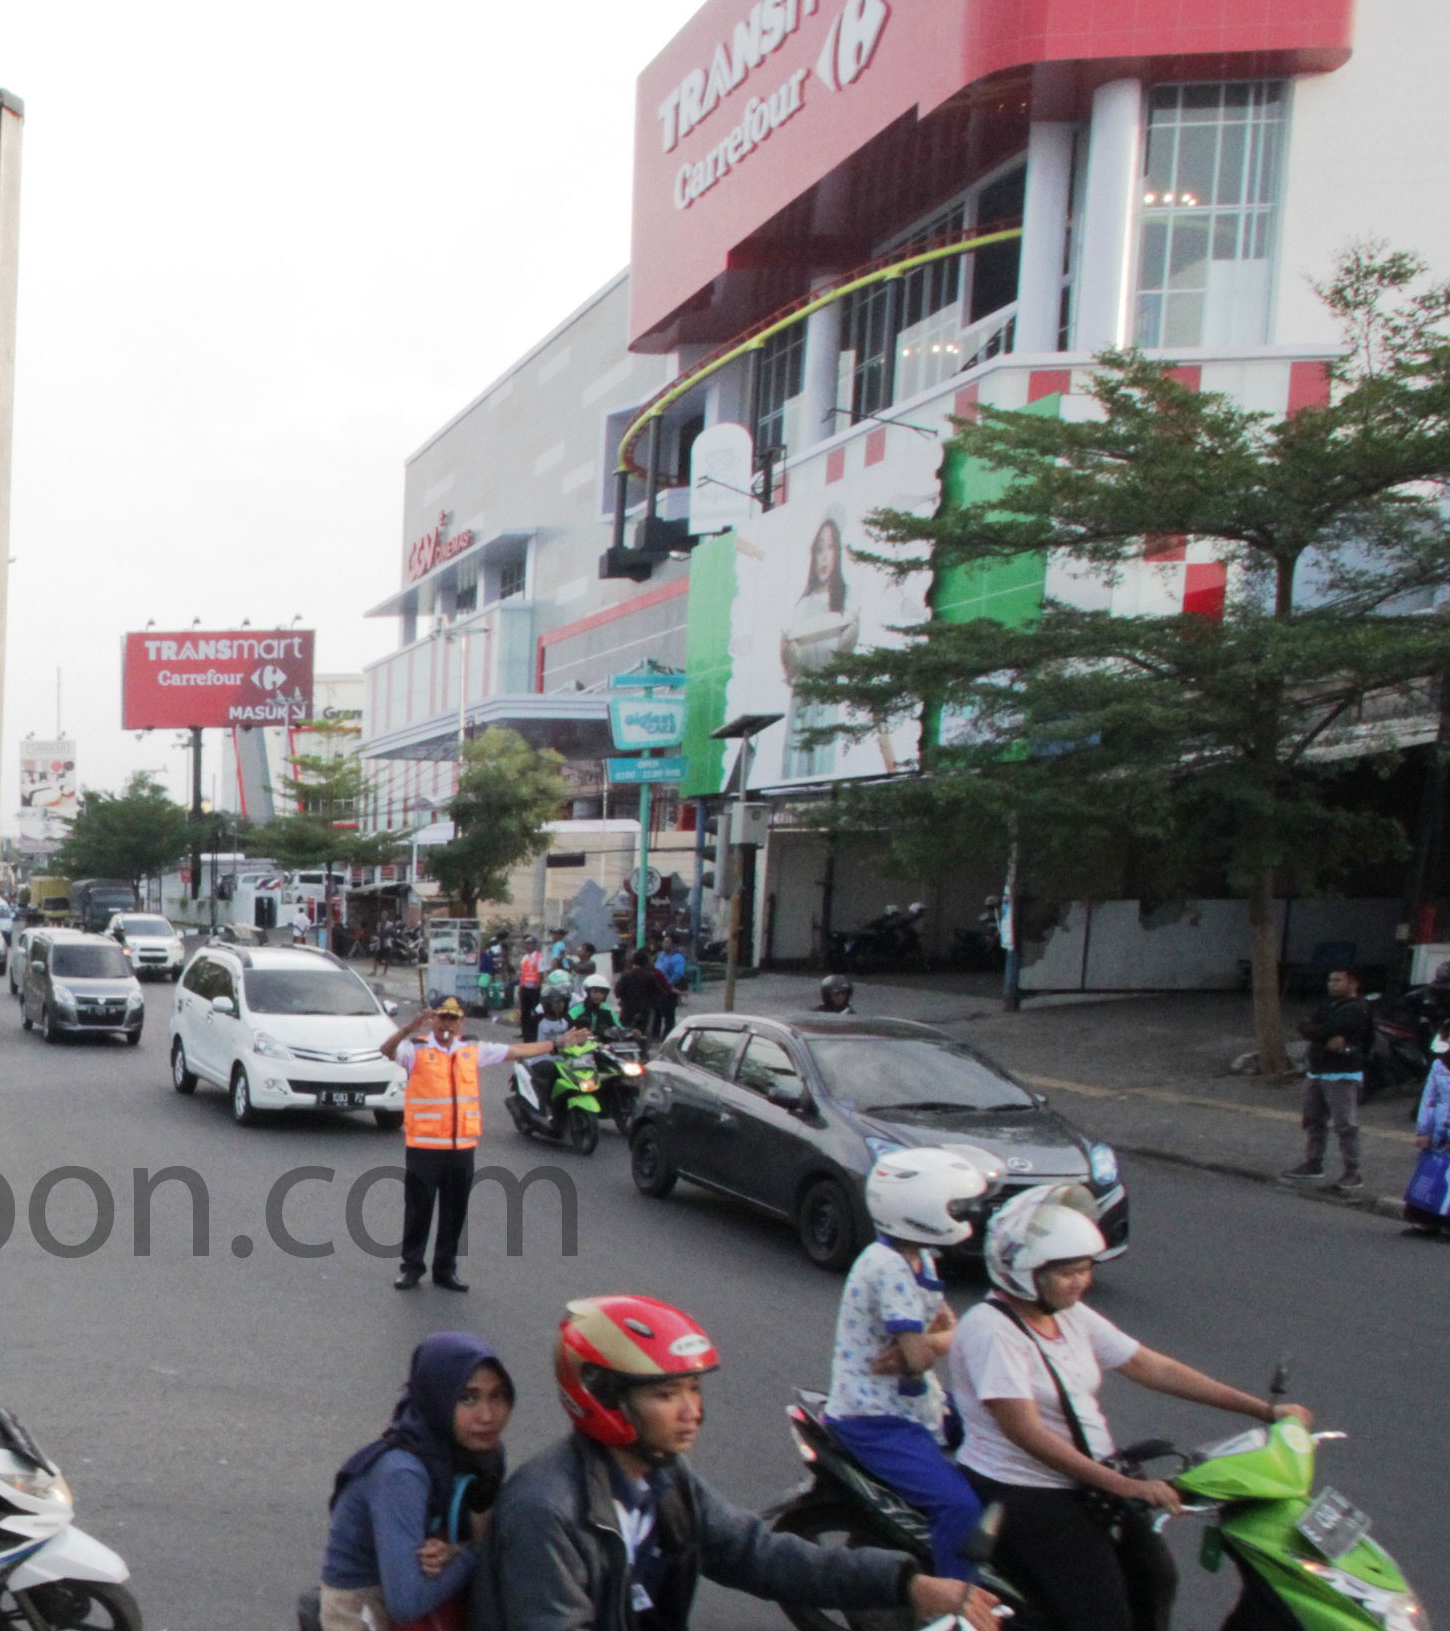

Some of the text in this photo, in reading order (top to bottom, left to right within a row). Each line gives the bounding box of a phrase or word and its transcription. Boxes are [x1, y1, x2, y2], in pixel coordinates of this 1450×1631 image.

[674, 68, 808, 210] Carrefour
[144, 636, 303, 661] TRANSmart
[157, 669, 245, 686] Carrefour
[229, 705, 288, 721] MASUK
